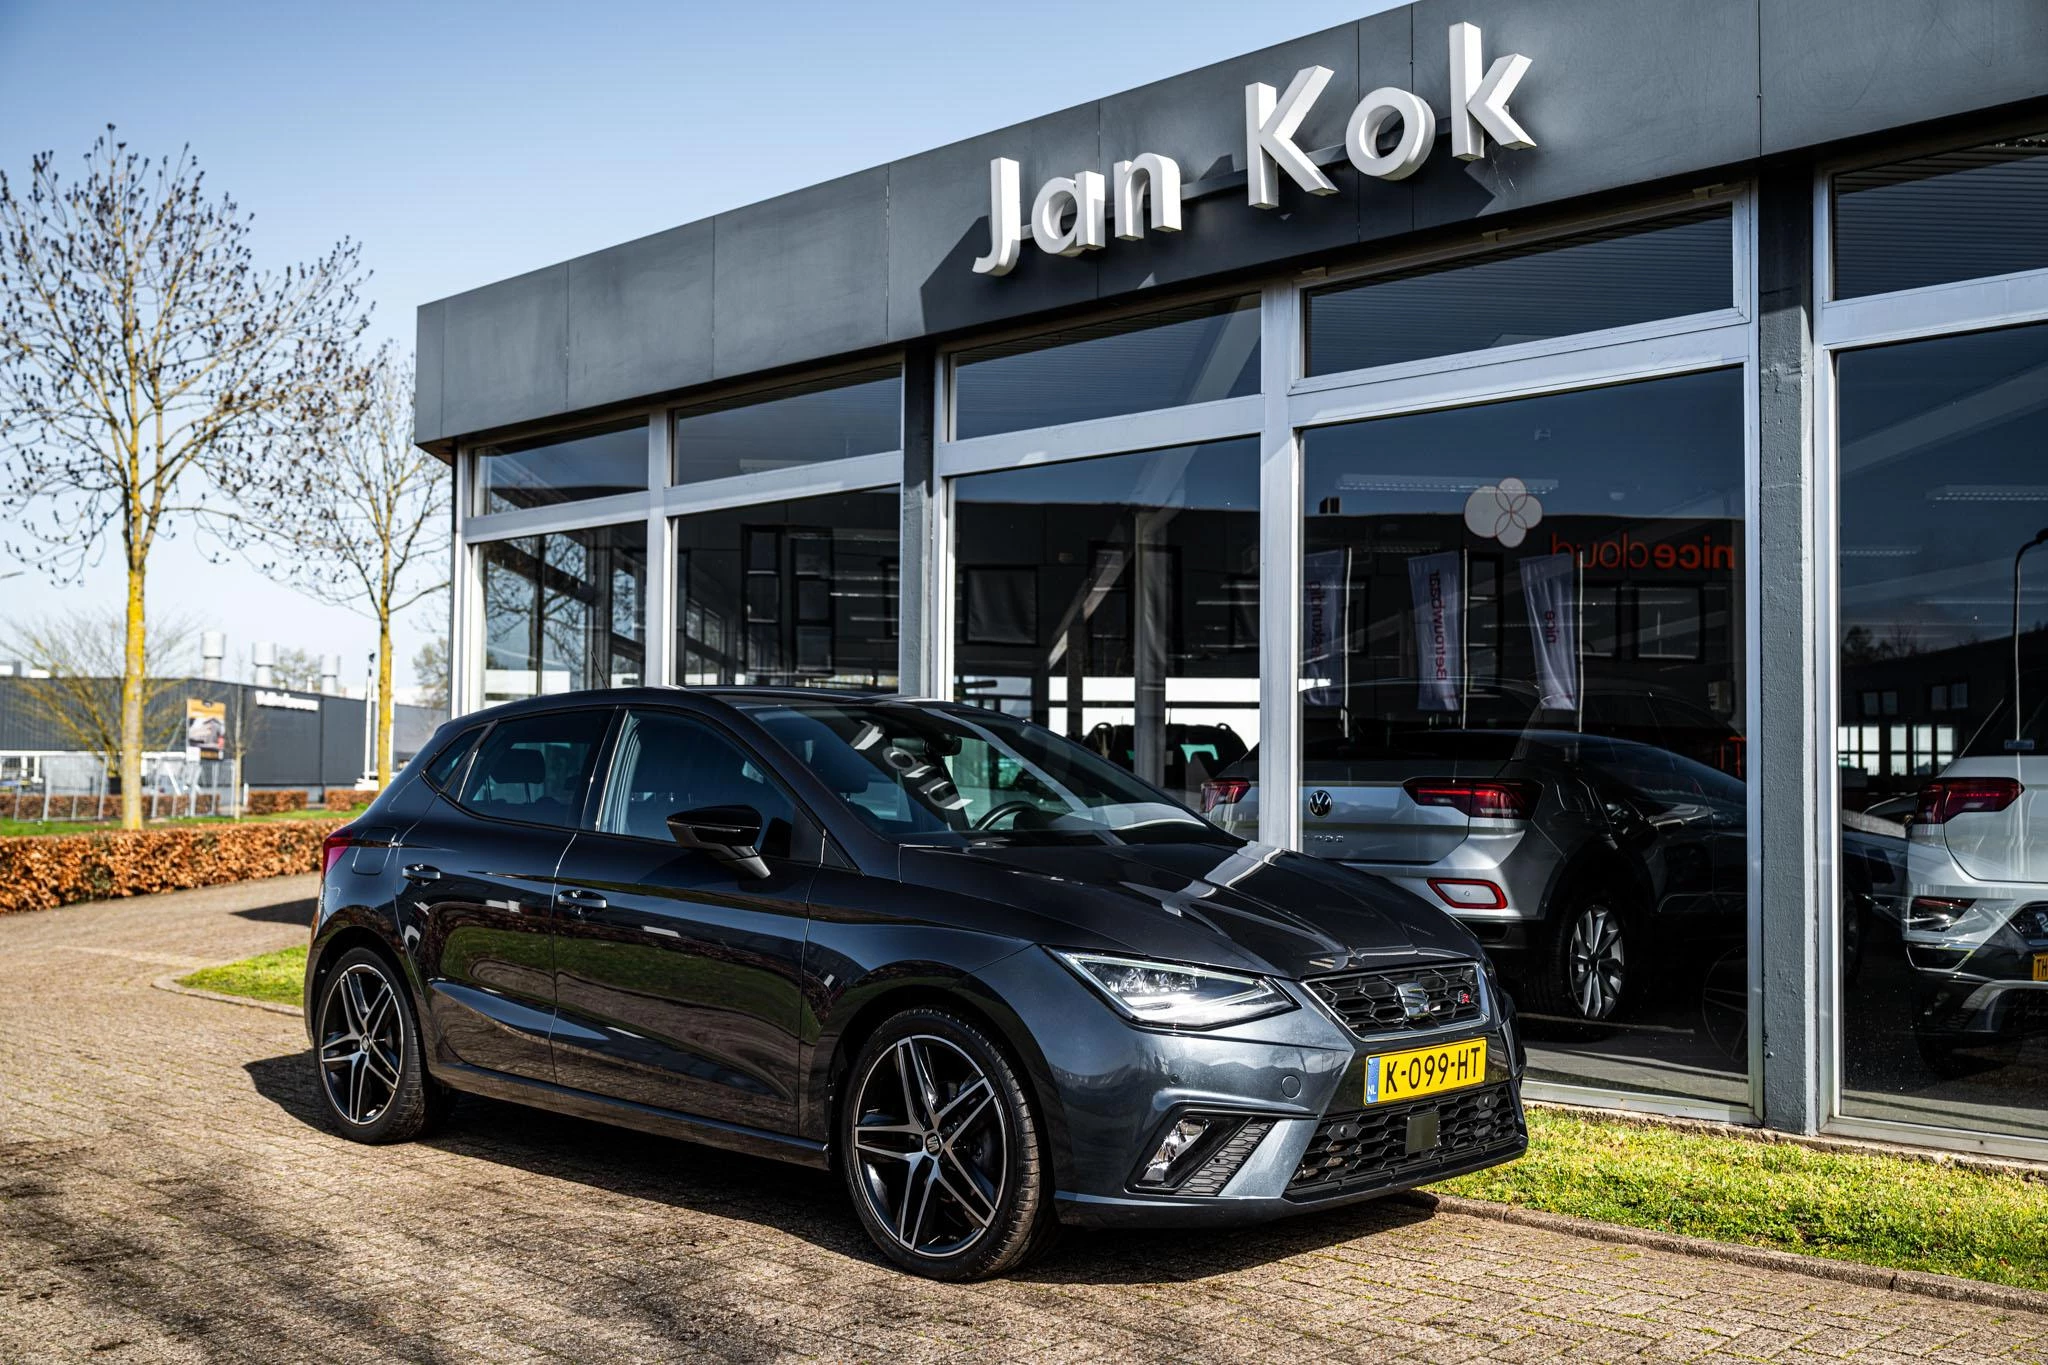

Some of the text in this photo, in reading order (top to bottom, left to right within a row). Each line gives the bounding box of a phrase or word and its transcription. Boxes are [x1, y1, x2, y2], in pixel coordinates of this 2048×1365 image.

[972, 21, 1537, 276] Jan Kok
[1368, 1047, 1480, 1095] NL K-099-HT
